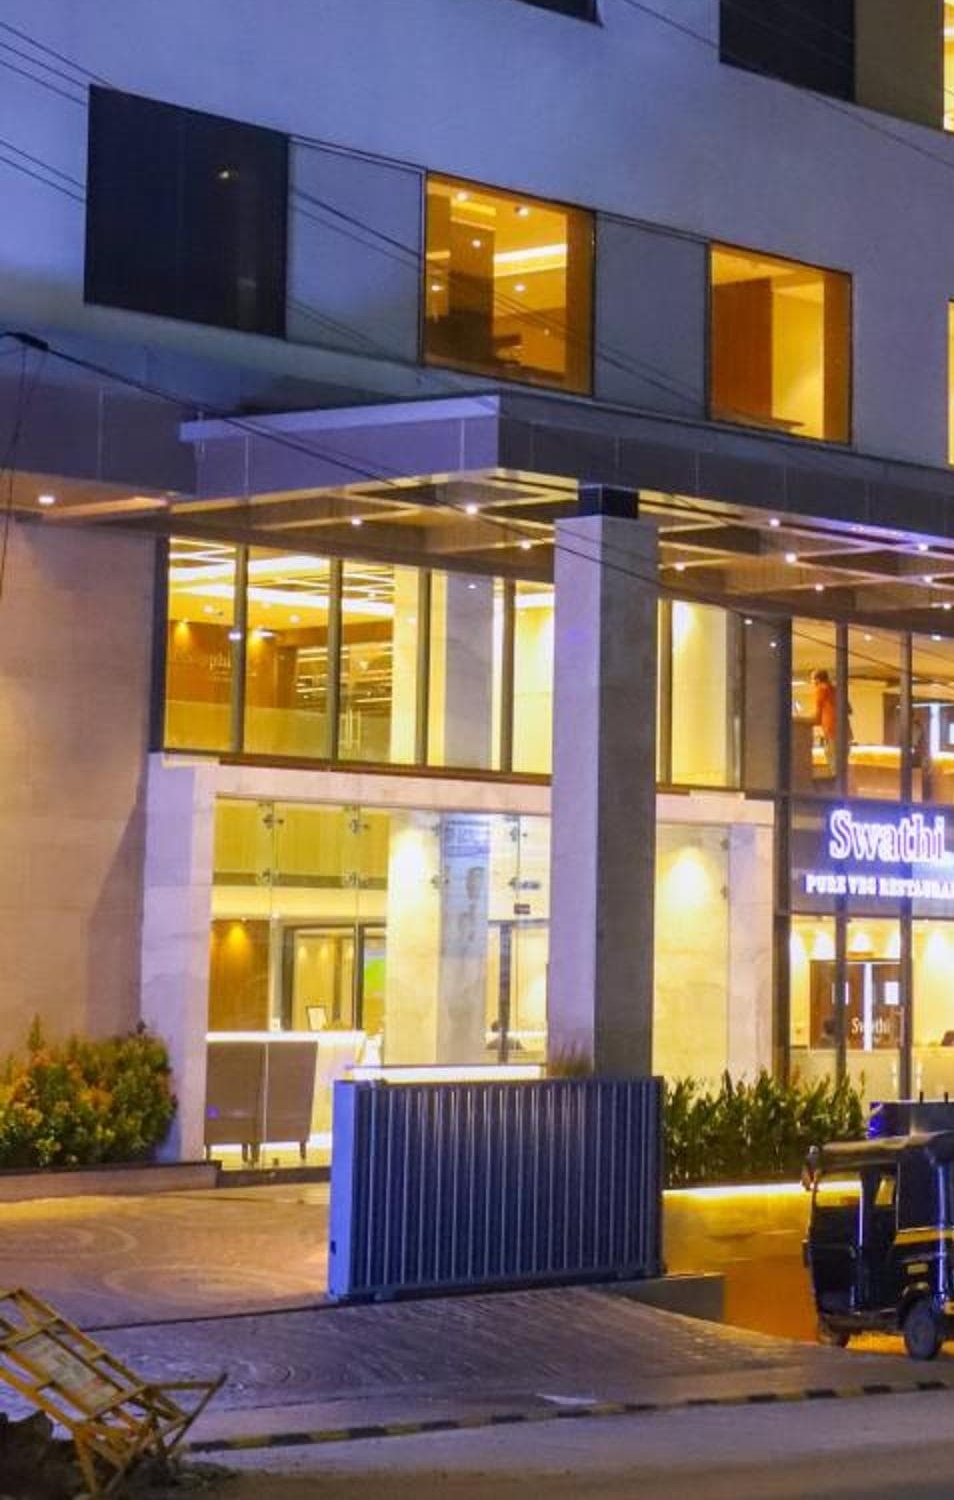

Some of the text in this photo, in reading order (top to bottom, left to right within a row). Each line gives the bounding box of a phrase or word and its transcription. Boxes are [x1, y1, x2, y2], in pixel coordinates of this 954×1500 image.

[829, 809, 946, 864] Swathi
[805, 874, 847, 894] PURE
[849, 876, 876, 895] VEG
